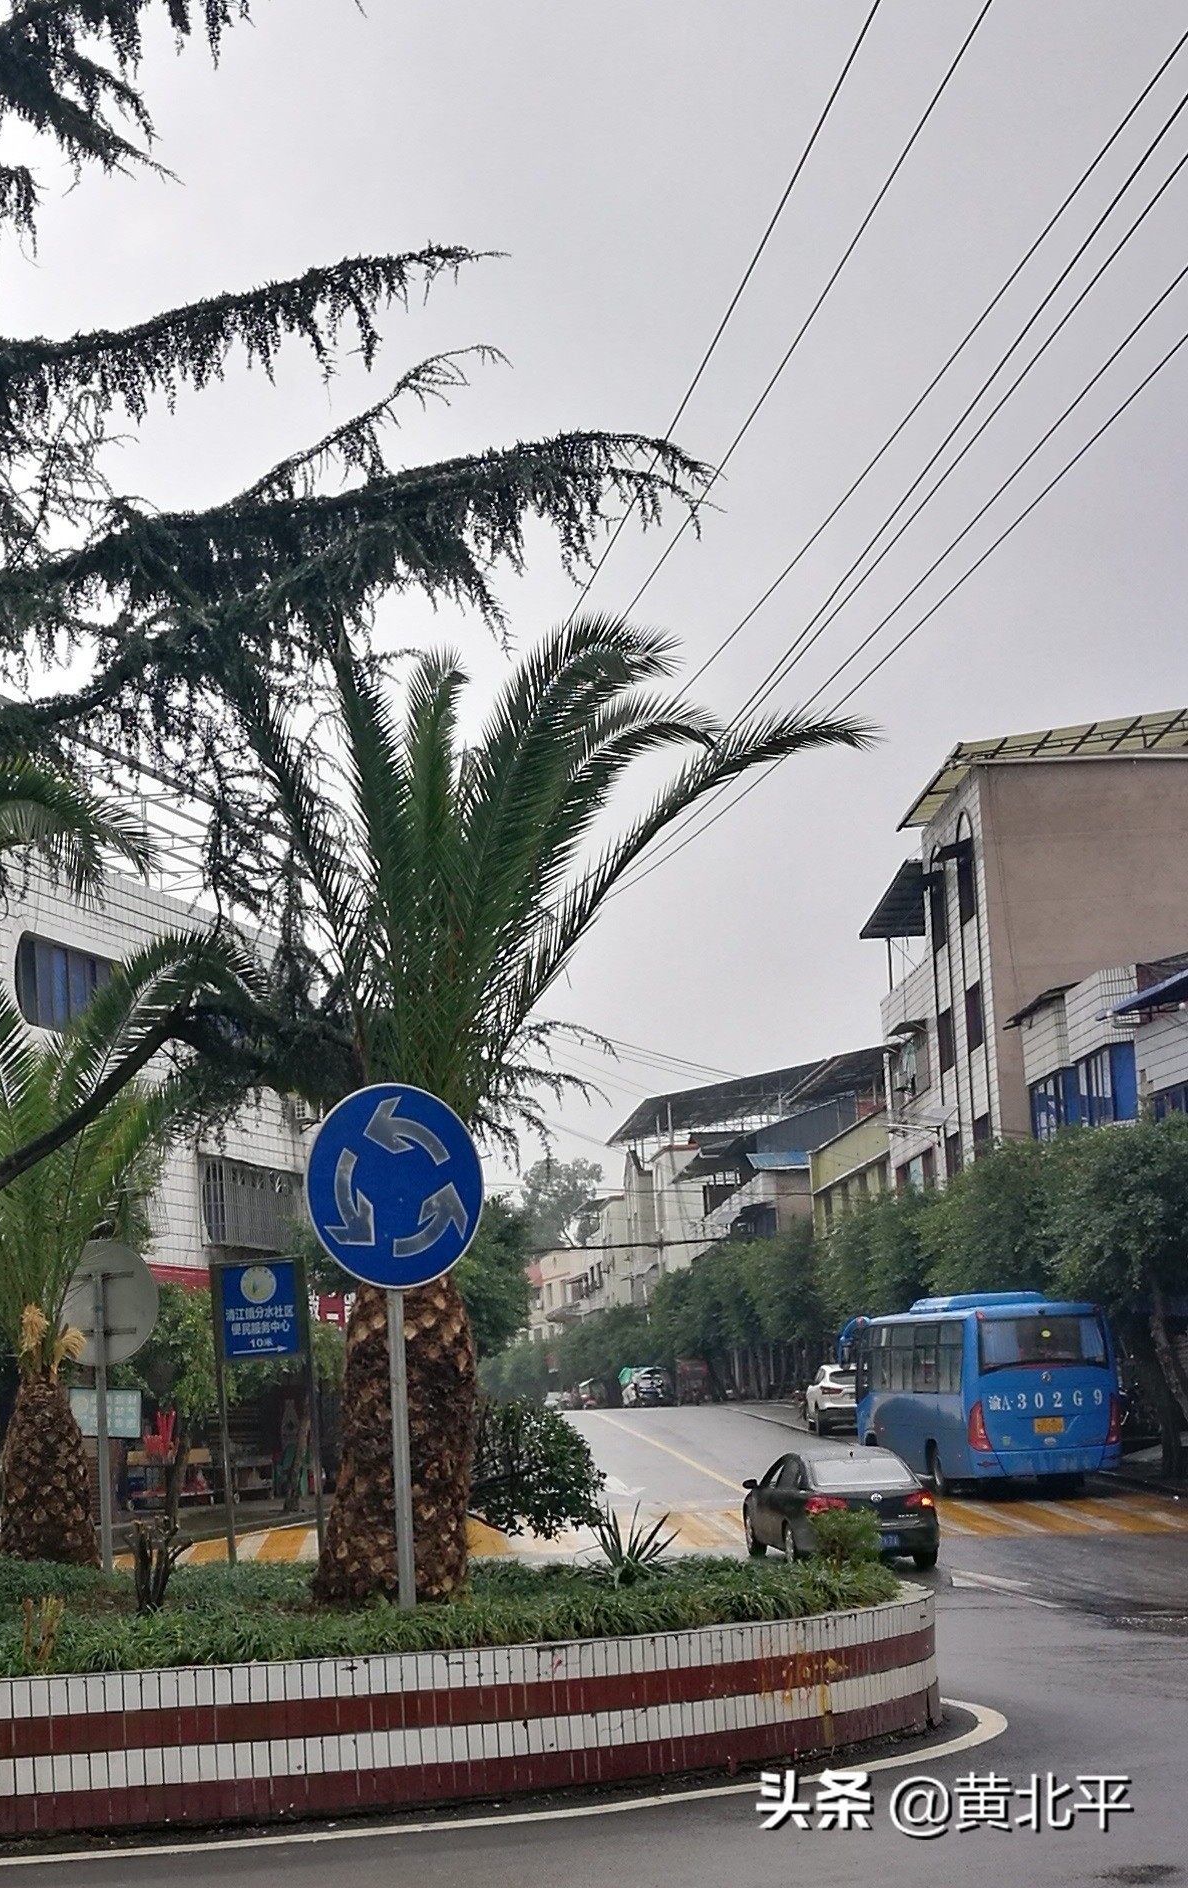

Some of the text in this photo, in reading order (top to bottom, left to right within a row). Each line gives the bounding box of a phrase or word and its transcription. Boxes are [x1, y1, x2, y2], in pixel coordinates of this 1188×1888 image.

[231, 1319, 291, 1336] 便民服务中心
[249, 1337, 273, 1348] 10米
